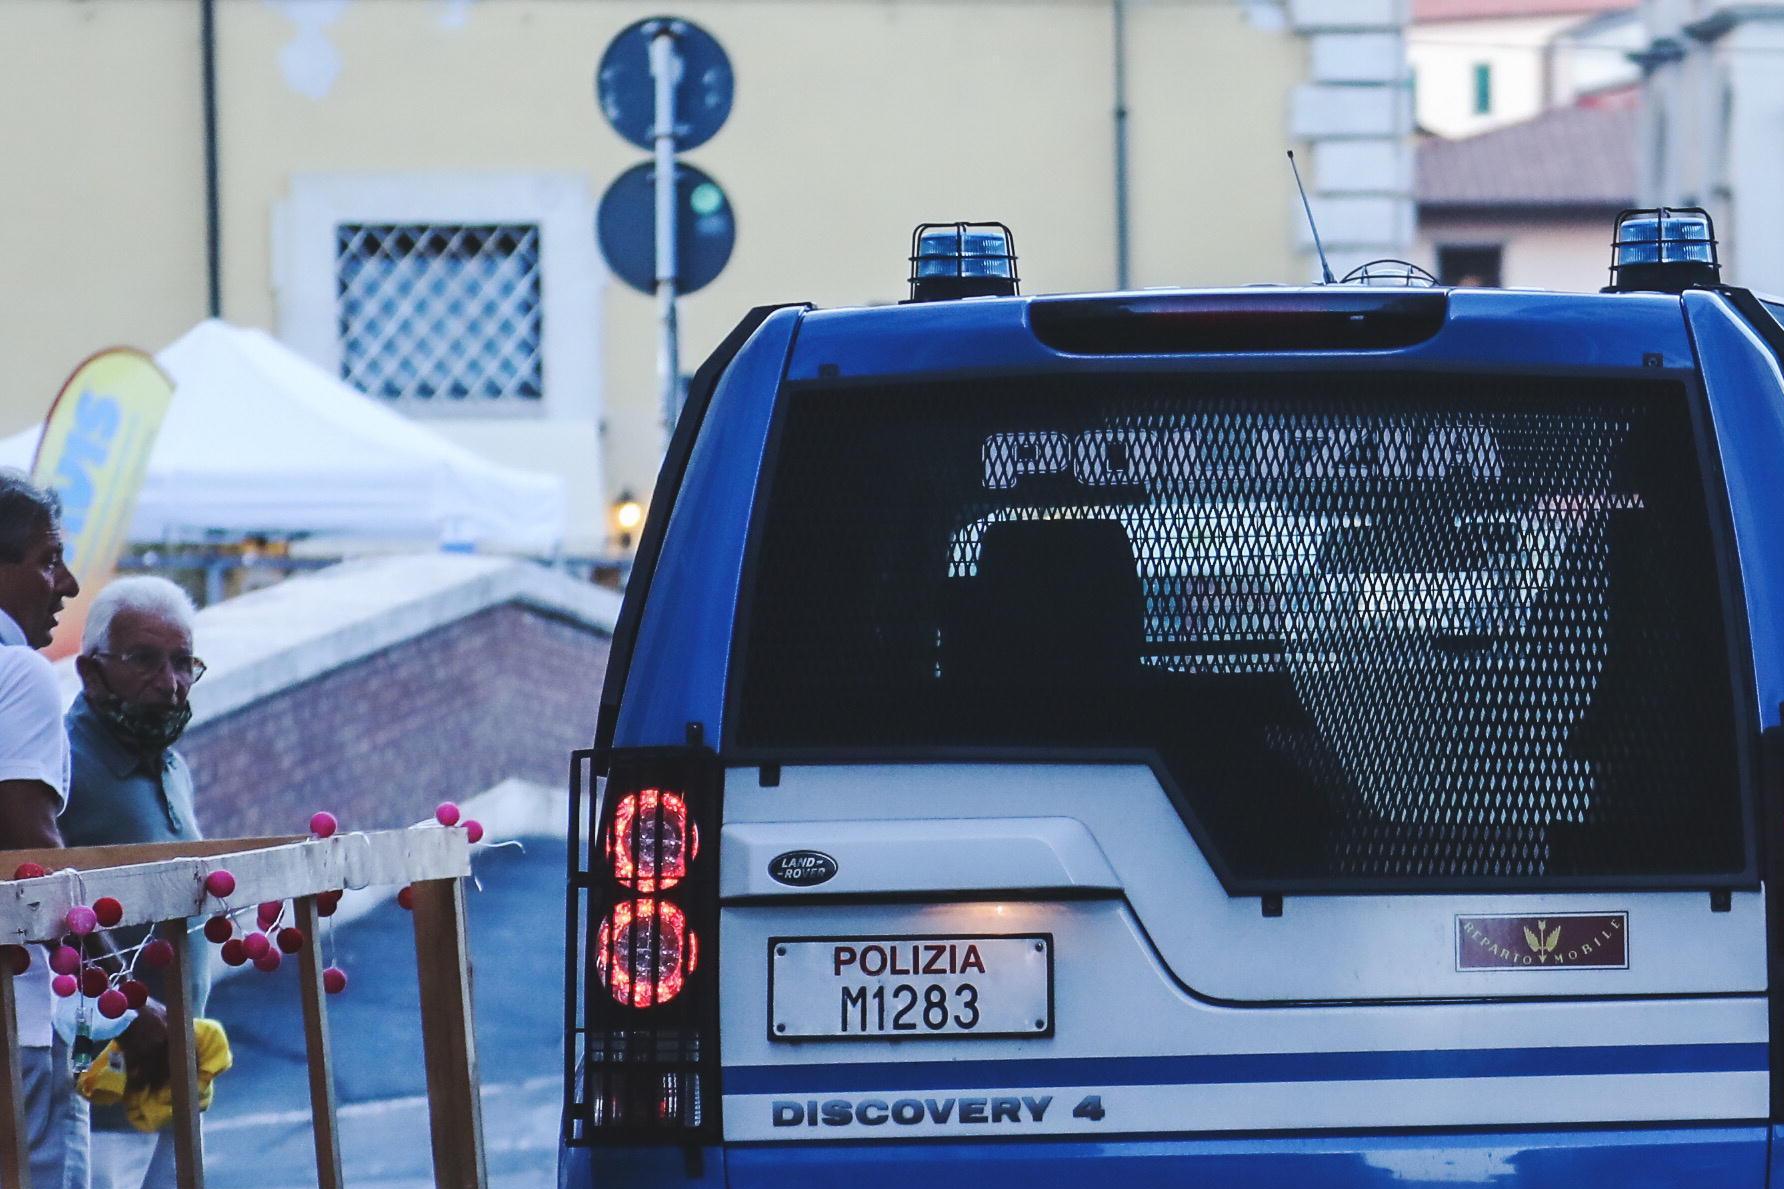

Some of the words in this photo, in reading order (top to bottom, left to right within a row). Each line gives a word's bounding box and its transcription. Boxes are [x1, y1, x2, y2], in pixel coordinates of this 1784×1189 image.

[982, 424, 1502, 489] POLIZIA
[834, 945, 986, 976] POLIZIA
[1463, 921, 1532, 965] REPARTO
[1554, 919, 1620, 964] MOBILE
[841, 983, 980, 1032] M1283
[772, 1096, 1053, 1127] DISCOVERY
[1072, 1095, 1106, 1122] 4
